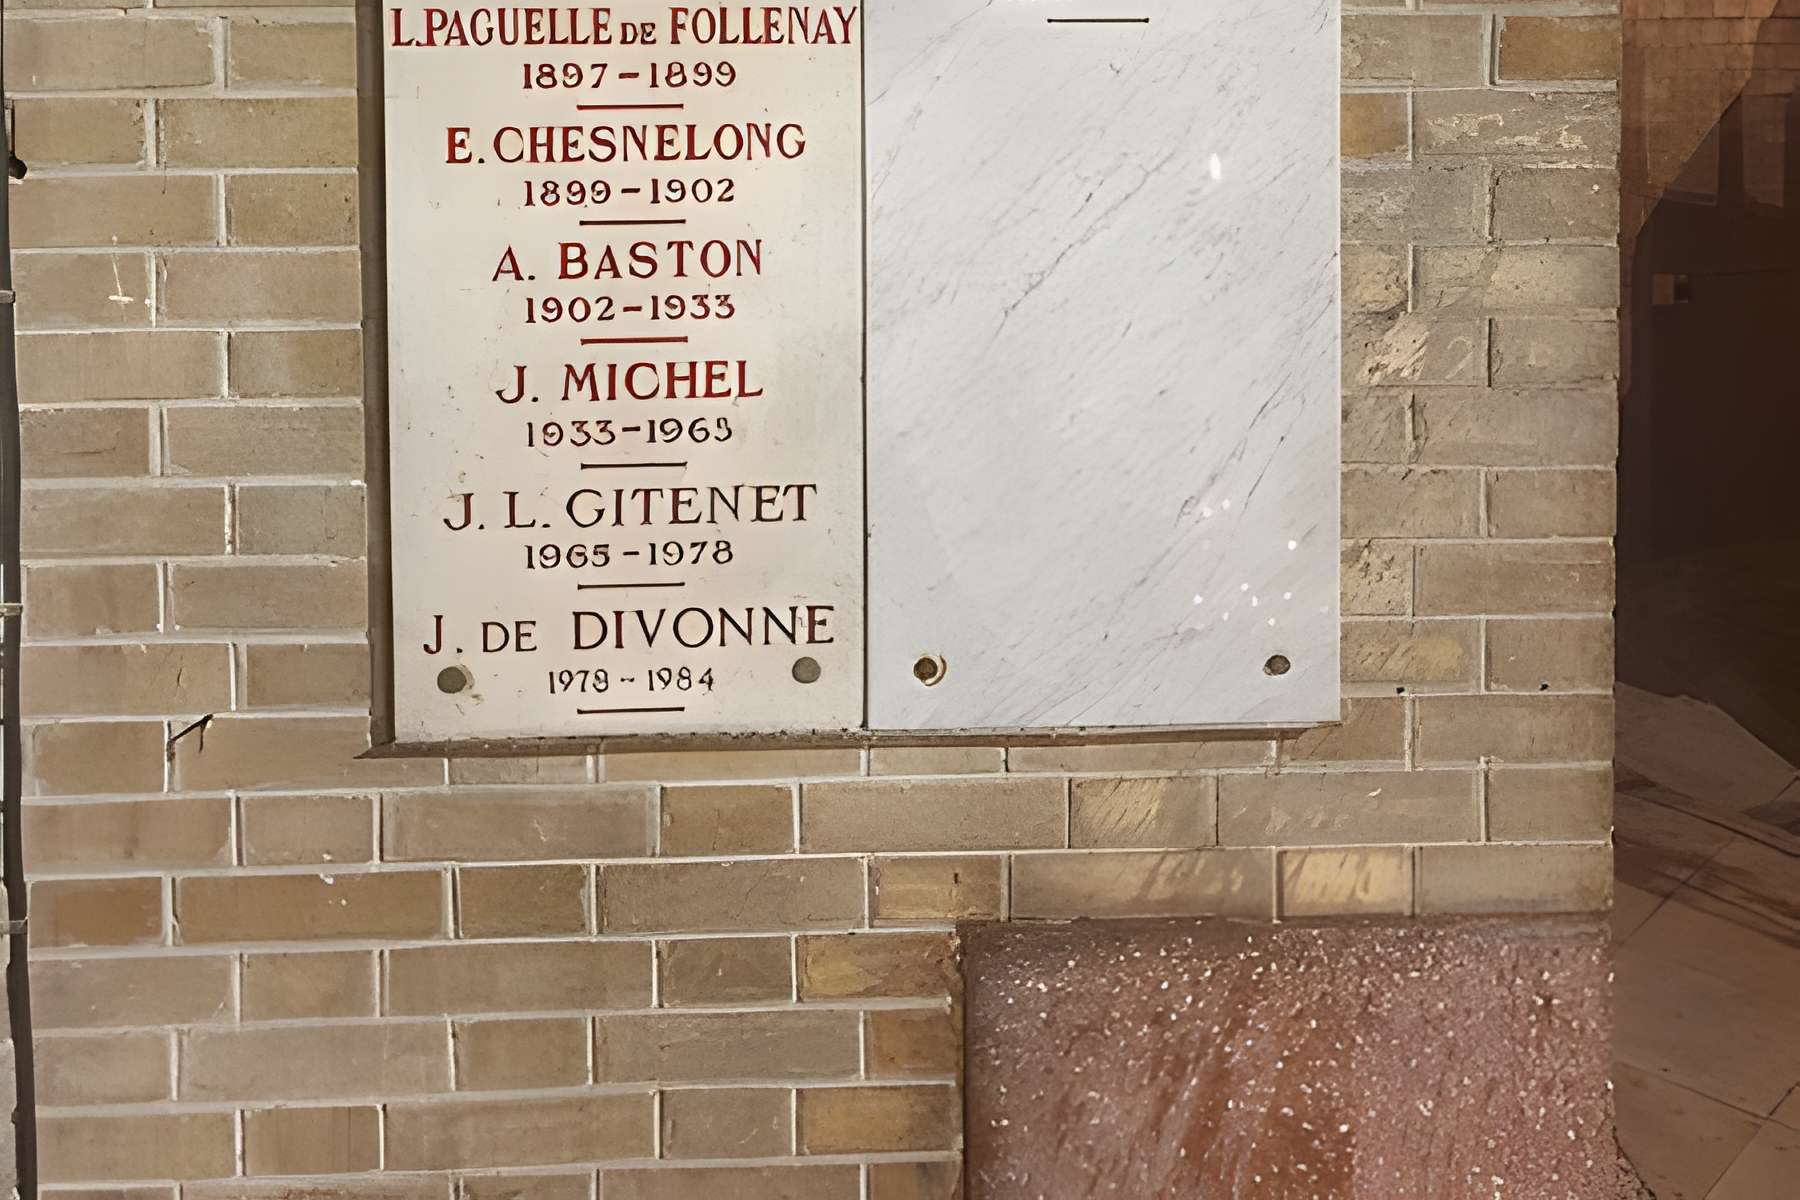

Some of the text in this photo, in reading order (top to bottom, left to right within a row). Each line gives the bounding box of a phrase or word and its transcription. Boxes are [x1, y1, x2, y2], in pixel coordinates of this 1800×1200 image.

[620, 22, 657, 46] DE
[668, 6, 858, 45] FOLLENAY
[492, 239, 763, 283] A. BASTON
[495, 360, 764, 404] J. MICHEL
[443, 484, 818, 531] J. L. GITENET
[423, 605, 835, 654] J. DE DIVONNE
